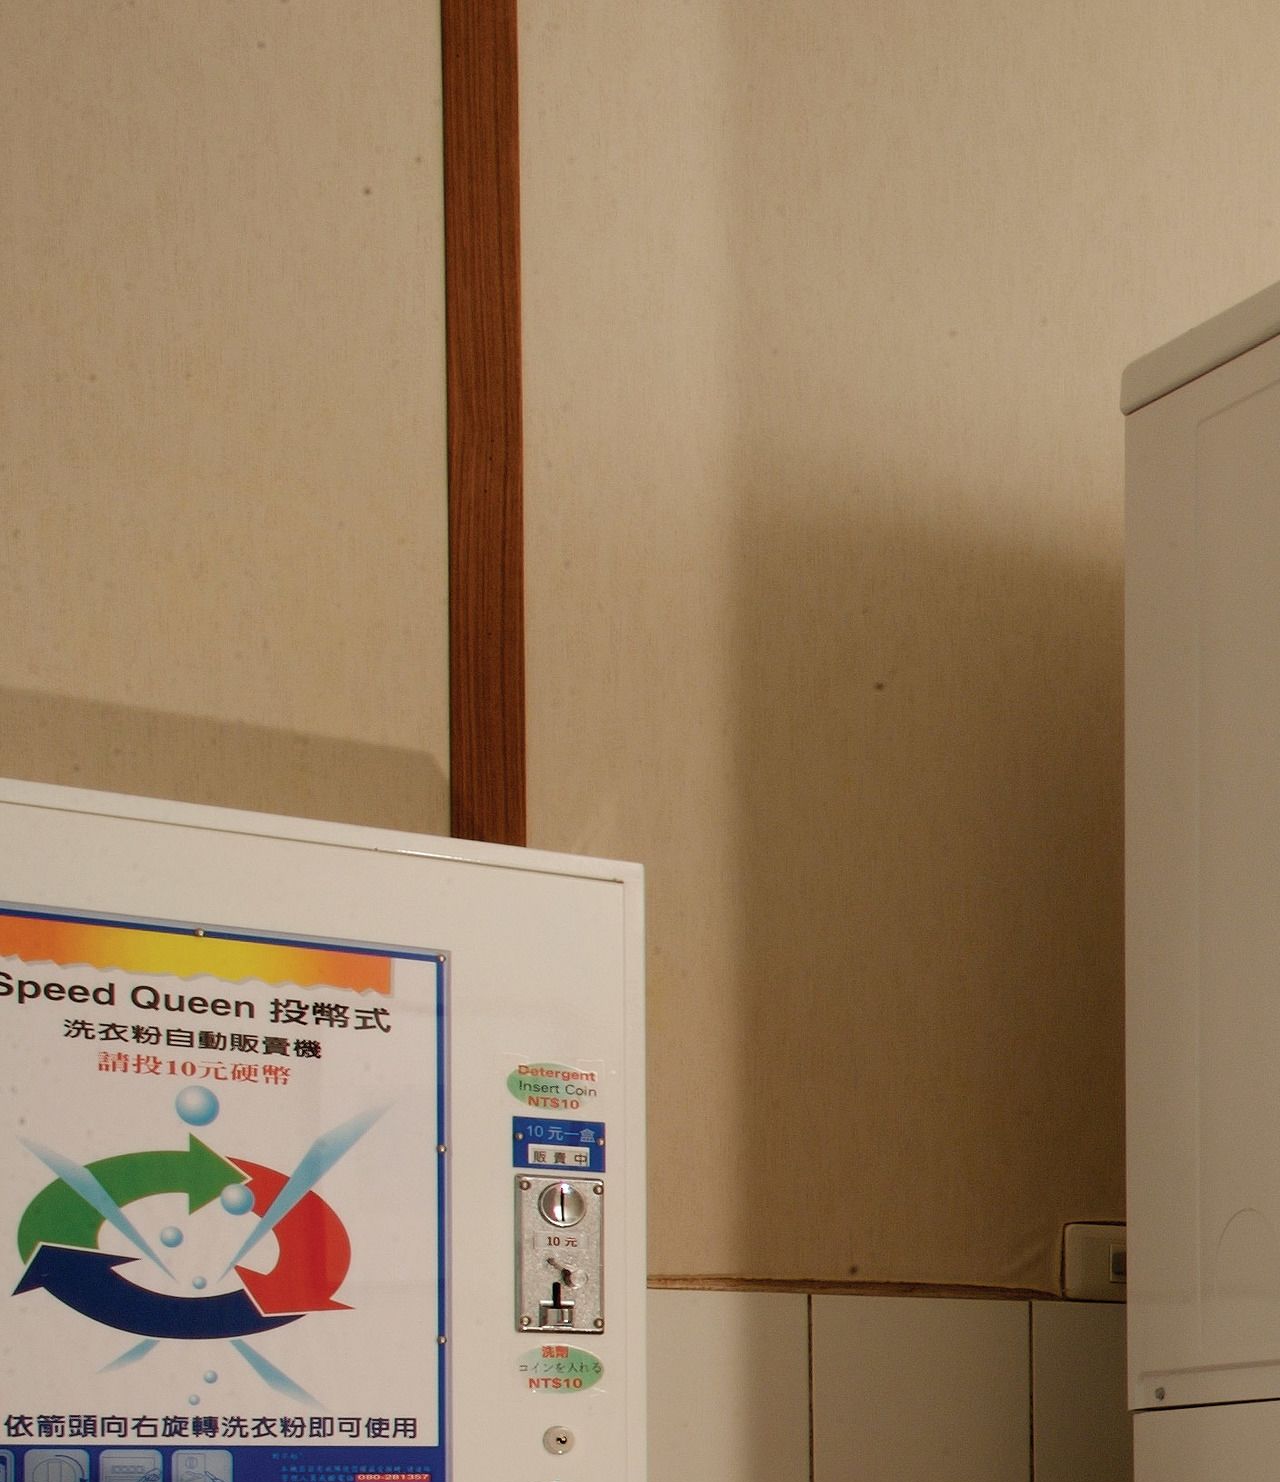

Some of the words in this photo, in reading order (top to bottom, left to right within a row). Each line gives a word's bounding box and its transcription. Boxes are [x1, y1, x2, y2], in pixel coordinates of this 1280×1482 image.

[131, 985, 255, 1019] Queen
[270, 998, 392, 1033] 投幣式
[97, 1051, 291, 1086] 請投10元硬幣
[518, 1064, 596, 1082] Detergent
[519, 1080, 560, 1094] Insert
[565, 1084, 597, 1097] Coin
[527, 1125, 544, 1138] 10
[547, 1236, 560, 1247] 10
[565, 1237, 577, 1247] 元
[3, 1414, 418, 1440] 依箭頭向右旋轉洗衣粉即可使用
